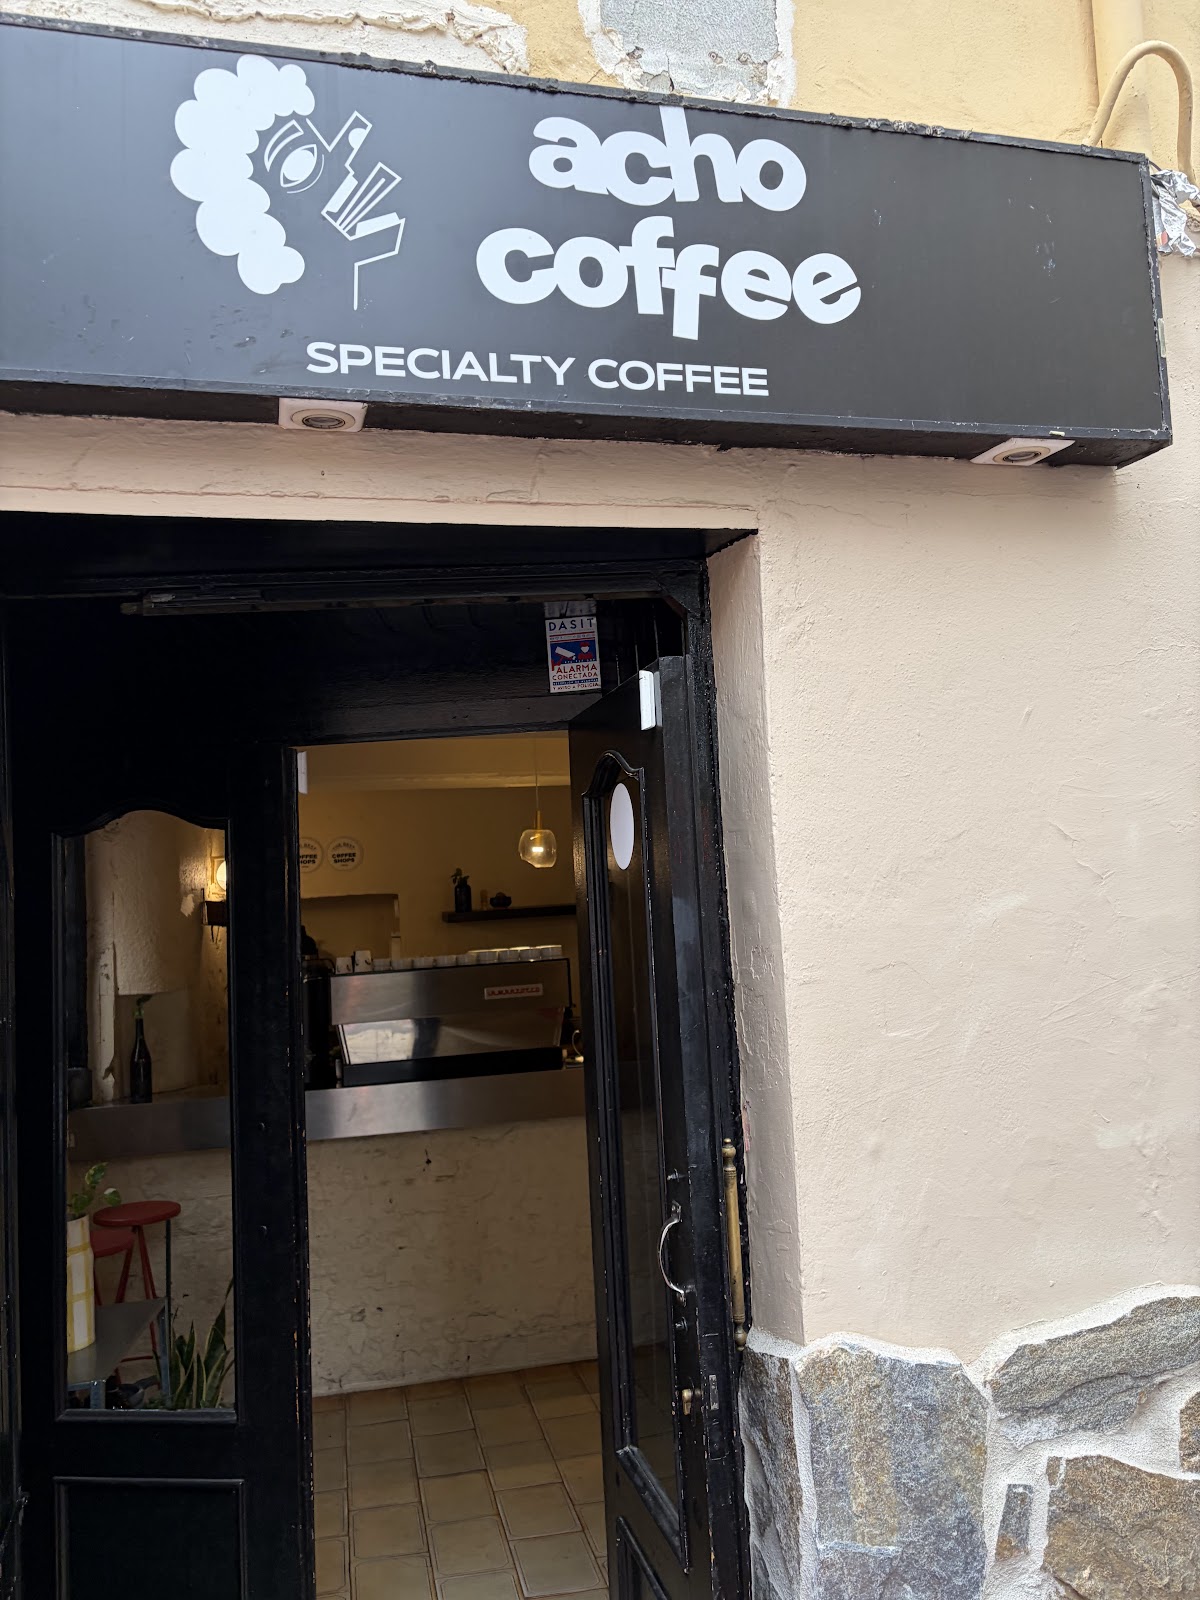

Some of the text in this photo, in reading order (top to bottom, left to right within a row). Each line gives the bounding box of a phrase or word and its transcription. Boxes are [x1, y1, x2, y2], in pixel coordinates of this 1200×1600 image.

[529, 106, 807, 212] acho
[476, 216, 862, 341] coffee
[306, 341, 770, 398] SPECIALTY COFFEE
[549, 618, 593, 631] DASIT
[552, 672, 598, 681] CONECTADA
[556, 664, 598, 674] ALARMA
